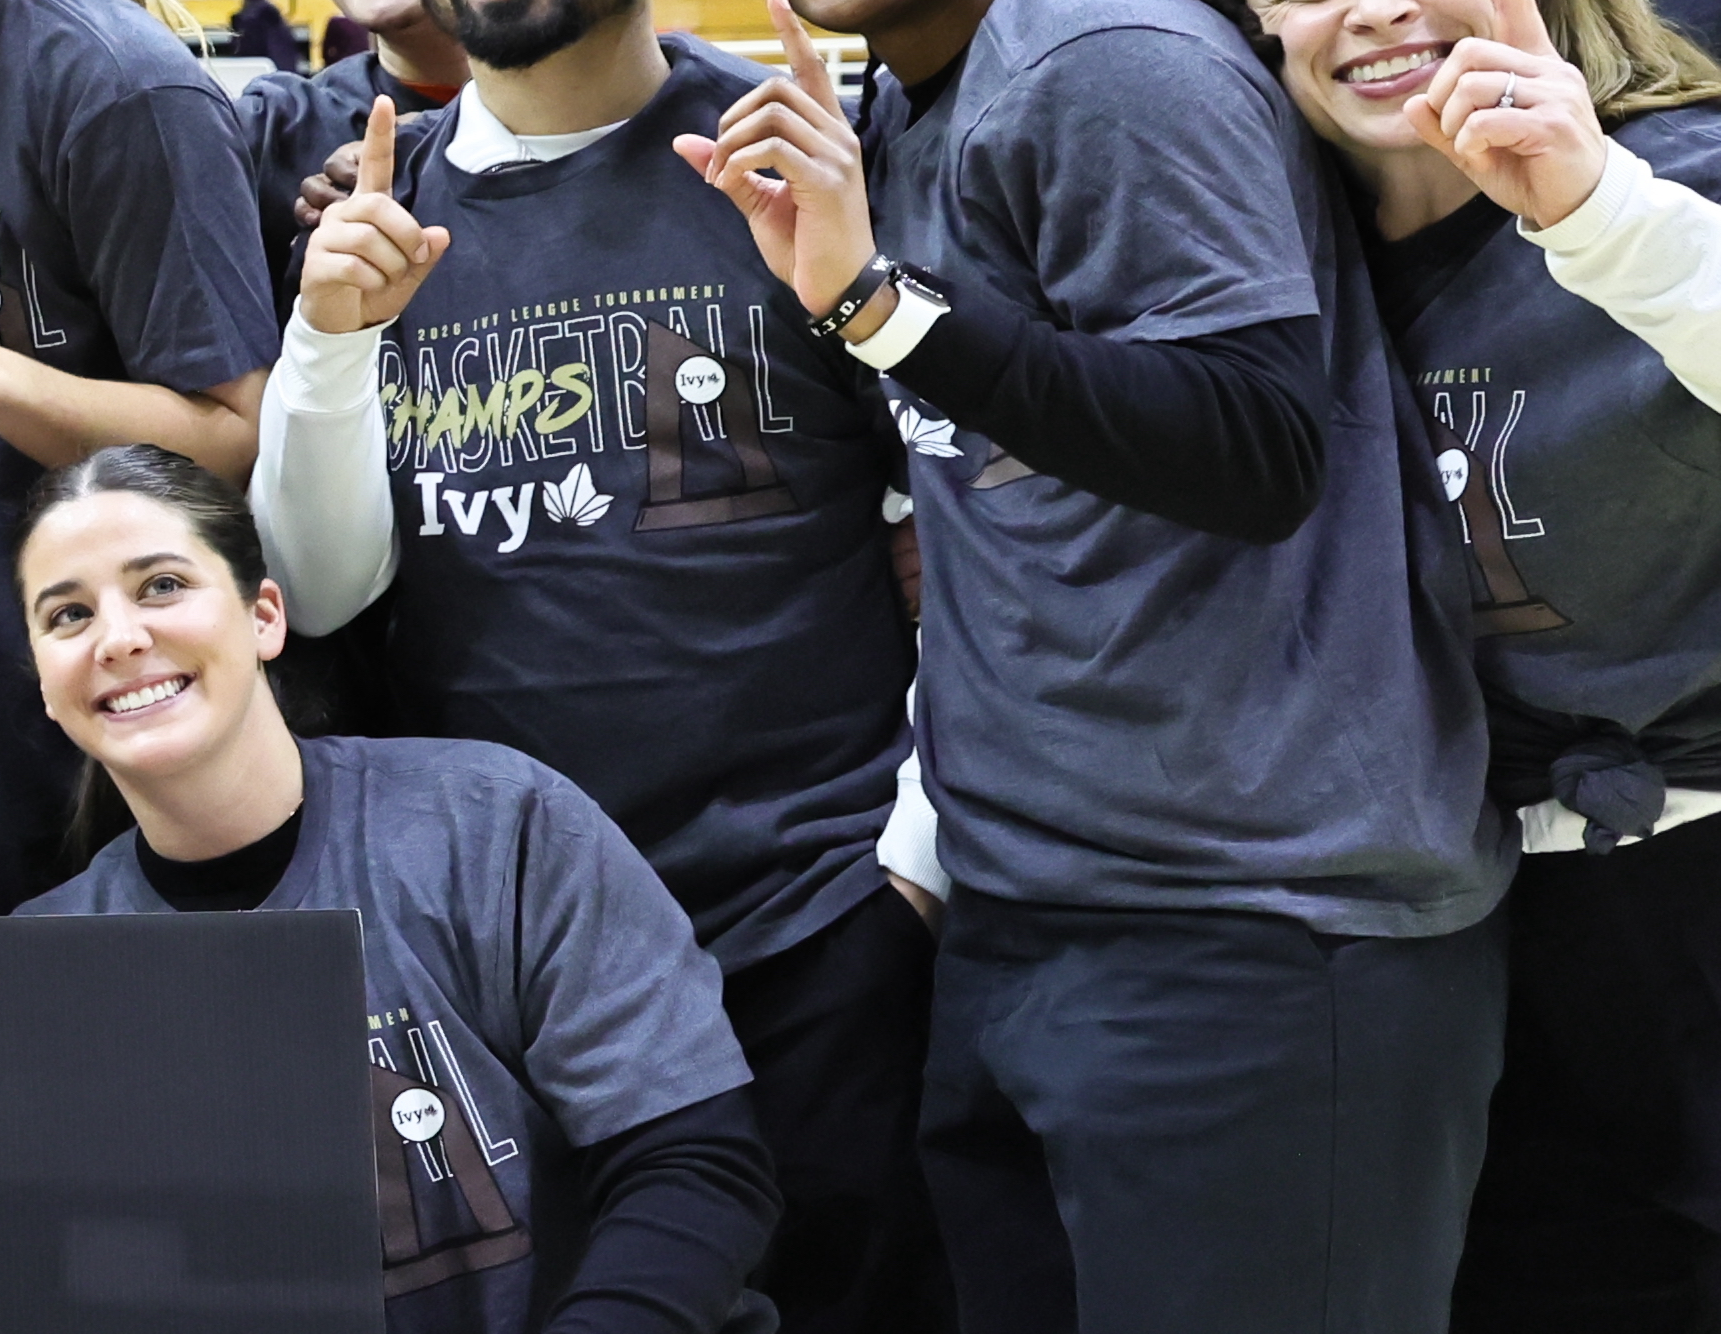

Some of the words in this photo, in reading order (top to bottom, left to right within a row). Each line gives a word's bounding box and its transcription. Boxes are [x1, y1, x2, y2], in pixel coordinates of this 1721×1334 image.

[417, 323, 462, 342] 2026
[473, 313, 500, 332] IVY
[511, 299, 581, 323] LEAGUE
[594, 283, 727, 308] TOURNAMENT
[381, 361, 593, 454] CHAMPS
[680, 372, 707, 390] Ivy
[413, 470, 536, 554] Ivy
[396, 1110, 422, 1125] Ivy
